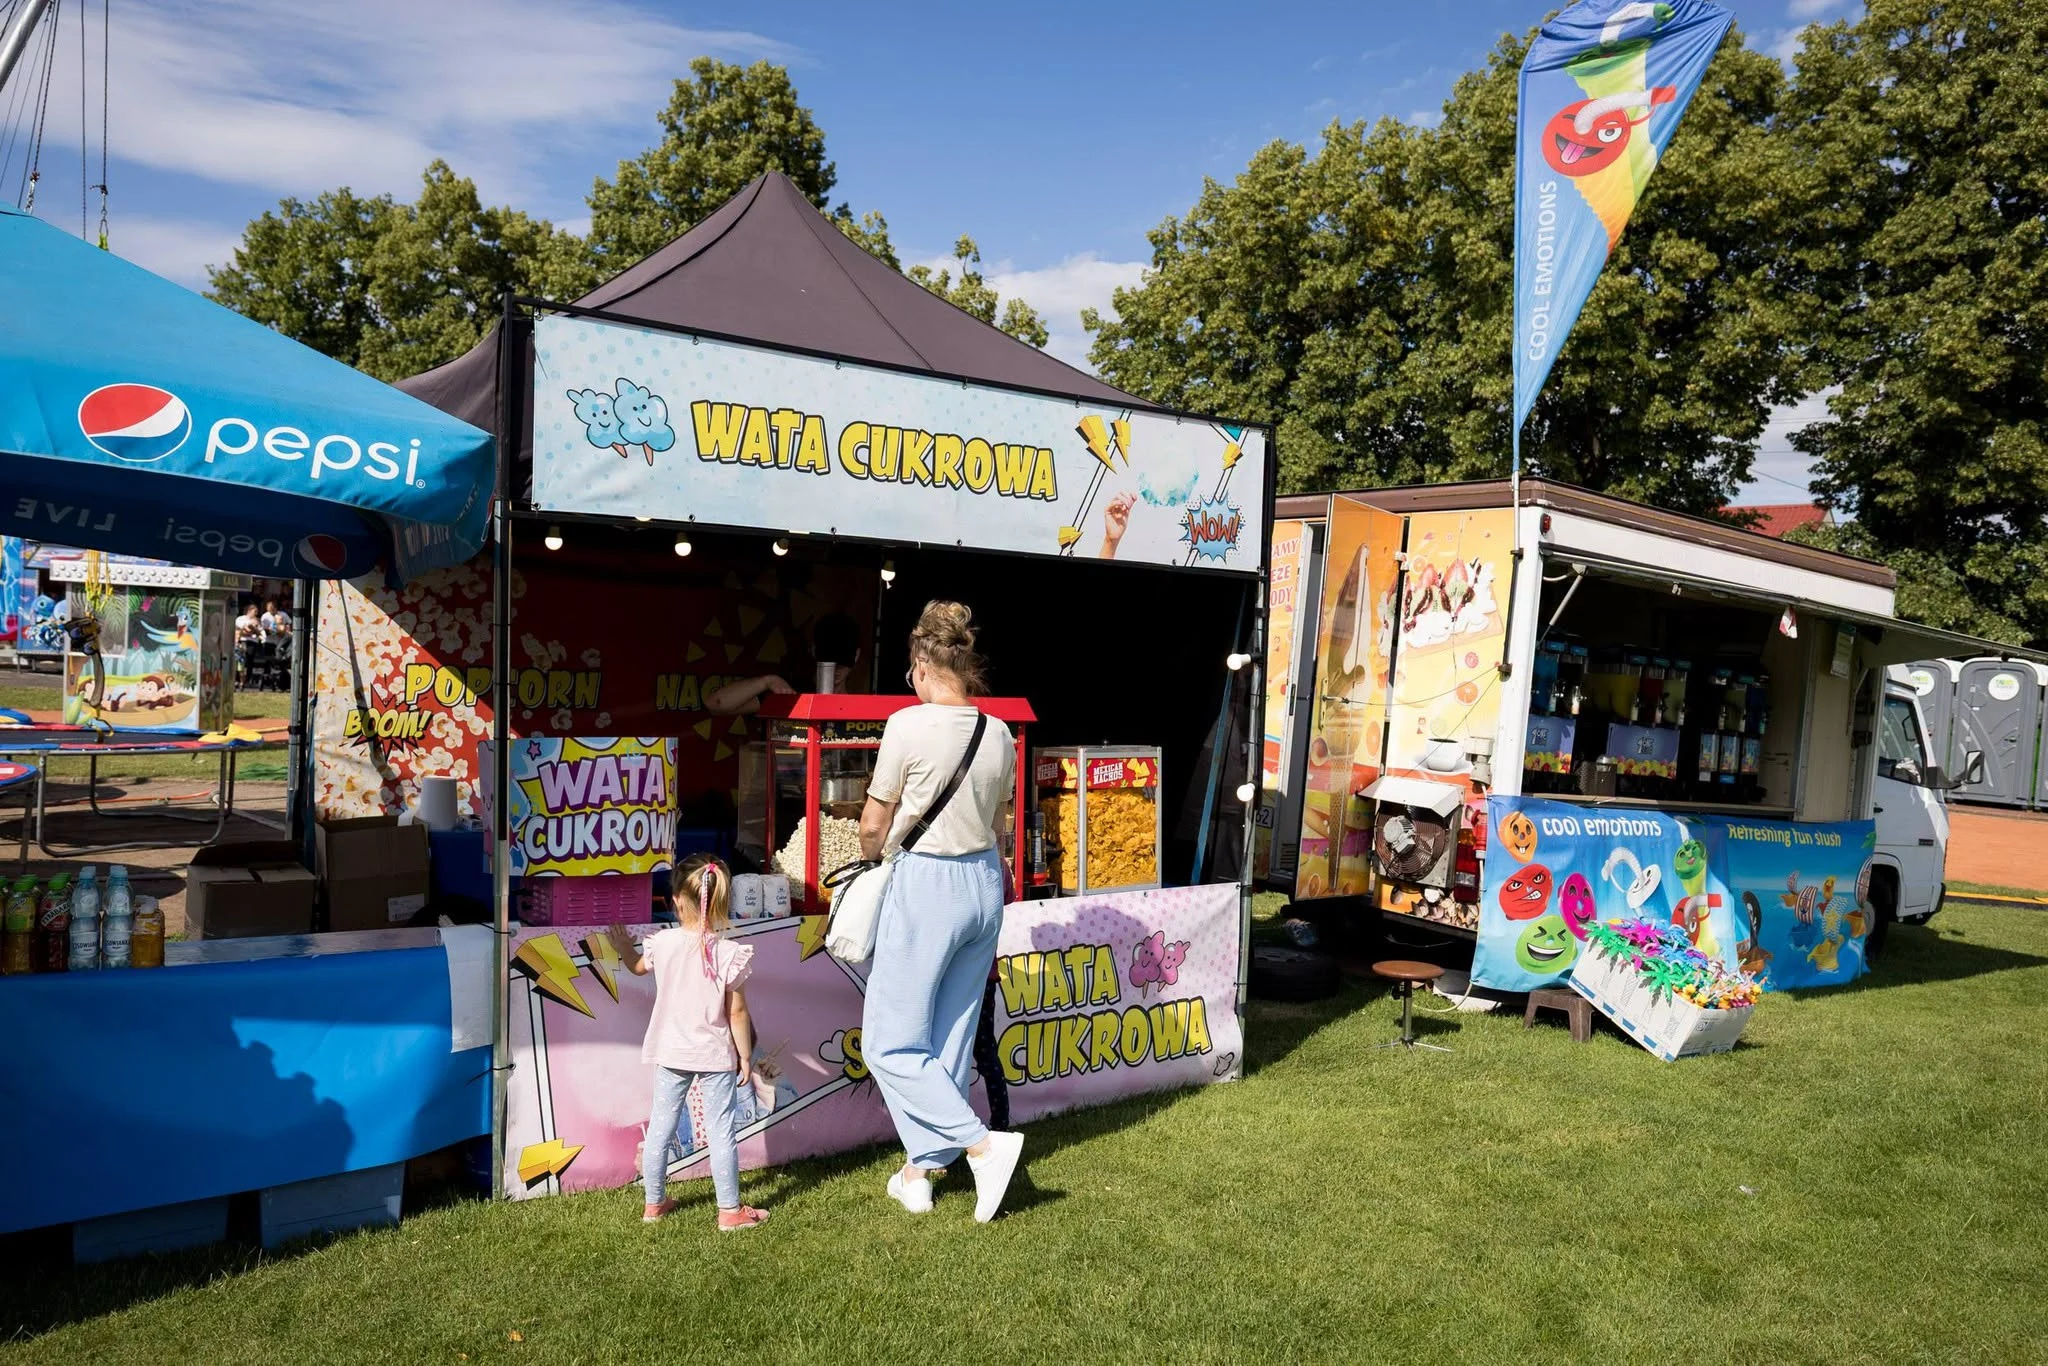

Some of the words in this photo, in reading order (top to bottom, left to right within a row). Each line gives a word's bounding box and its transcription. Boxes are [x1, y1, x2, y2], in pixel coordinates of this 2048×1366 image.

[1535, 180, 1557, 295] EMOTIONS
[1529, 300, 1550, 361] COOL
[205, 418, 426, 489] pepsi
[690, 400, 831, 475] WATA
[838, 421, 1058, 502] CUKROWA
[1187, 510, 1241, 545] WOW!
[1272, 539, 1299, 557] AMY
[1270, 587, 1293, 606] ODY
[343, 707, 432, 740] BOOM!
[537, 753, 667, 813] WATA
[1093, 762, 1123, 774] MEXICAN
[1093, 770, 1123, 785] NACHOS
[523, 808, 677, 865] CUKROWA
[1542, 815, 1580, 836] cool
[1585, 816, 1662, 837] emotions
[1815, 828, 1841, 847] slush
[999, 944, 1121, 1018] WATA
[997, 996, 1213, 1086] CUKROWA
